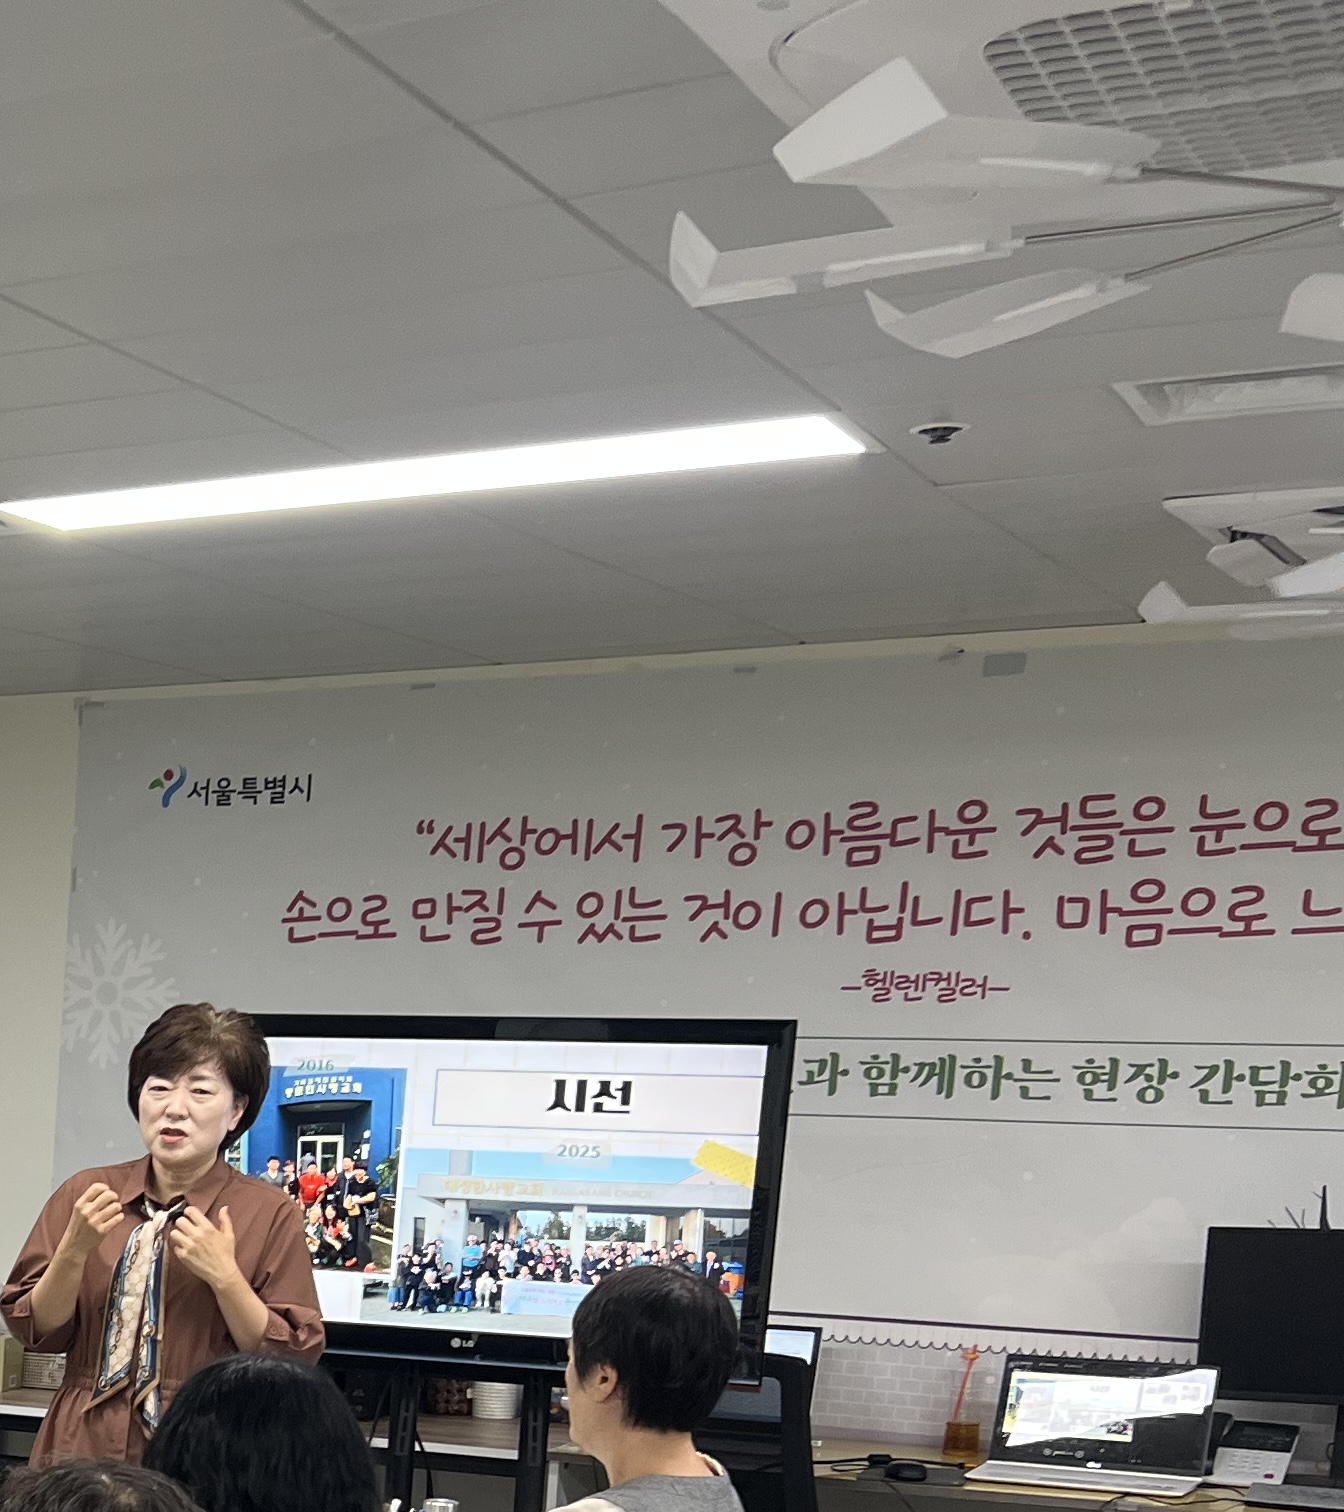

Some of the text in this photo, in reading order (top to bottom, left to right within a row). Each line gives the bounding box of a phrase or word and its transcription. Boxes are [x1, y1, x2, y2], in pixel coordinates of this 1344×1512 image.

[187, 773, 313, 807] 서울특별시
[415, 793, 1344, 871] “세상에서 가장 아름다운 것들은 눈으로
[281, 889, 397, 943] 손으로
[411, 887, 506, 945] 만질
[517, 889, 563, 943] 수
[575, 887, 668, 944] 있는
[684, 888, 783, 943] 것이
[798, 881, 1033, 945] 아닙니다.
[1056, 878, 1277, 948] 마음으로
[296, 1059, 334, 1071] 2016
[858, 1052, 1062, 1101] 함께하는
[1072, 1056, 1180, 1105] 현장
[1189, 1057, 1344, 1110] 간담회
[545, 1078, 633, 1114] 시선
[557, 1143, 601, 1159] 2025
[462, 1340, 474, 1348] LG
